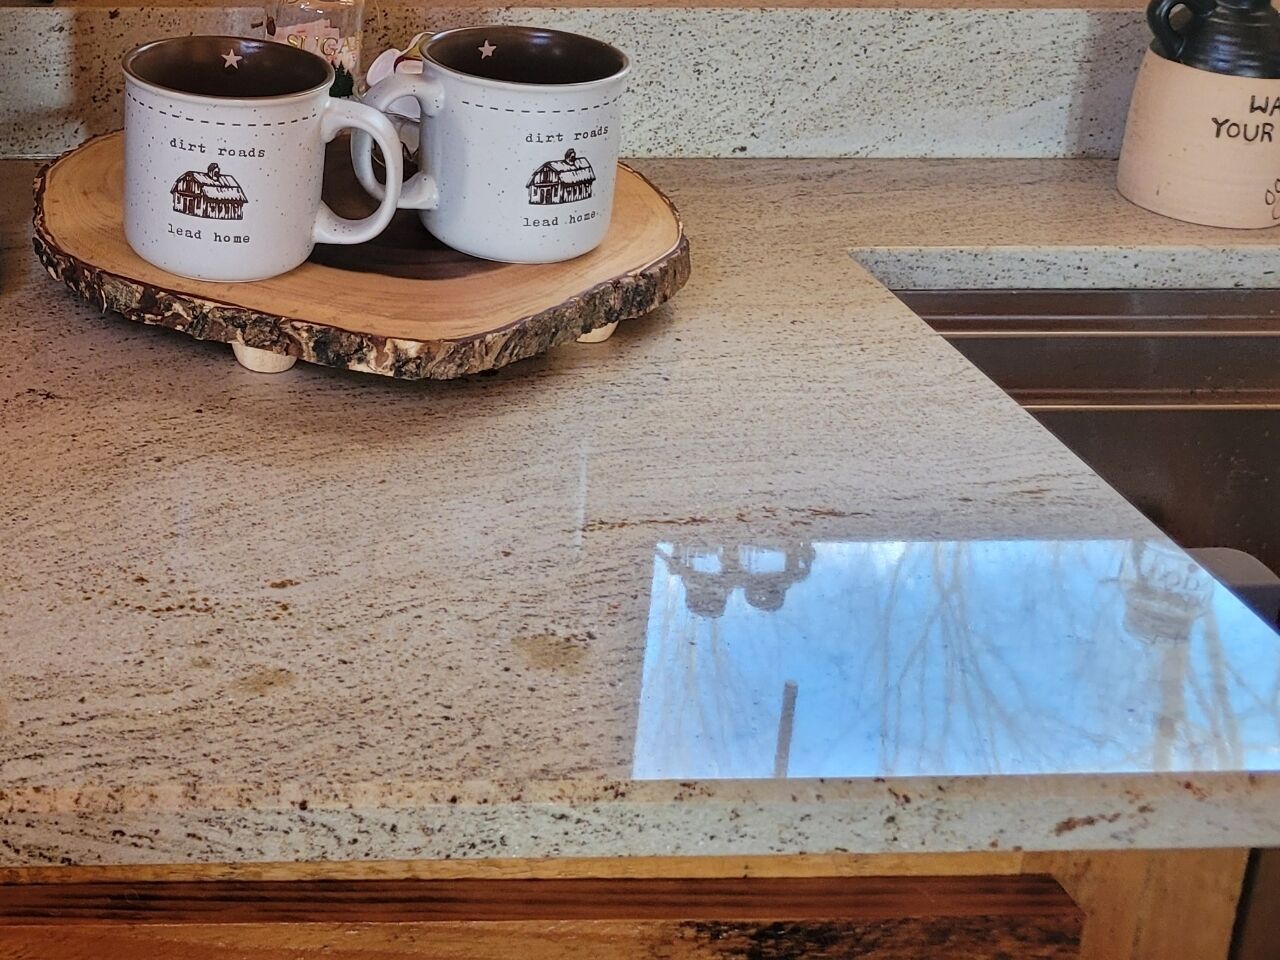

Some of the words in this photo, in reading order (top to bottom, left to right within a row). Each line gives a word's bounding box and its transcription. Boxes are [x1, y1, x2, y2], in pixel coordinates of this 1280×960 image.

[525, 132, 564, 143] dirt
[574, 125, 610, 141] roads
[1211, 116, 1274, 143] YOUR
[169, 138, 207, 154] dirt
[217, 145, 267, 159] roads
[523, 216, 559, 227] lead
[569, 210, 597, 225] home
[168, 223, 202, 240] lead
[214, 232, 251, 244] home
